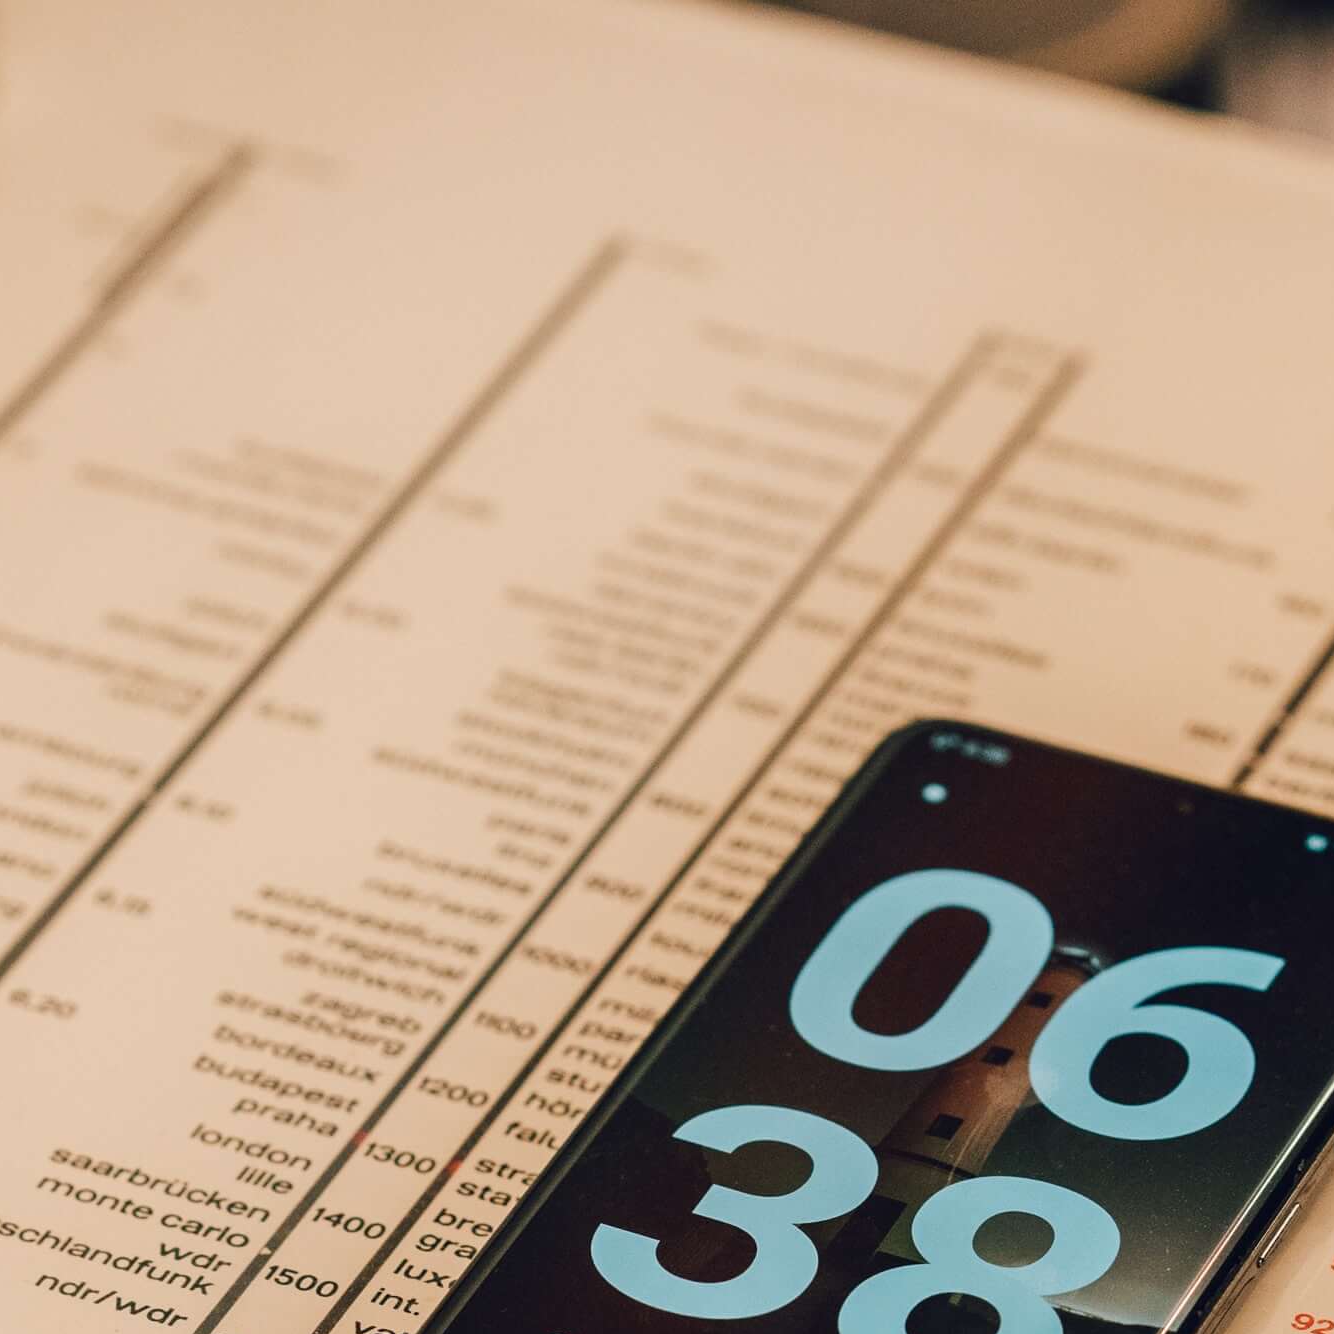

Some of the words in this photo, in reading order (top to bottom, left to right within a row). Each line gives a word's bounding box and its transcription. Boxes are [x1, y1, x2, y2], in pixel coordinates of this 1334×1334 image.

[789, 867, 1287, 1142] 06
[213, 1023, 383, 1085] bordeaux
[192, 1054, 360, 1115] budapest
[418, 1075, 490, 1109] 1200
[233, 1098, 340, 1141] praha
[190, 1123, 313, 1172] london
[362, 1142, 436, 1175] 1300
[50, 1147, 272, 1224] saarbrücken
[236, 1166, 294, 1196] lille
[36, 1174, 154, 1221] monte
[160, 1210, 251, 1250] carlo
[311, 1207, 387, 1240] 1400
[158, 1241, 232, 1274] wdr
[35, 1271, 188, 1330] ndr/wdr
[264, 1264, 340, 1299] 1500
[370, 1286, 420, 1317] int.
